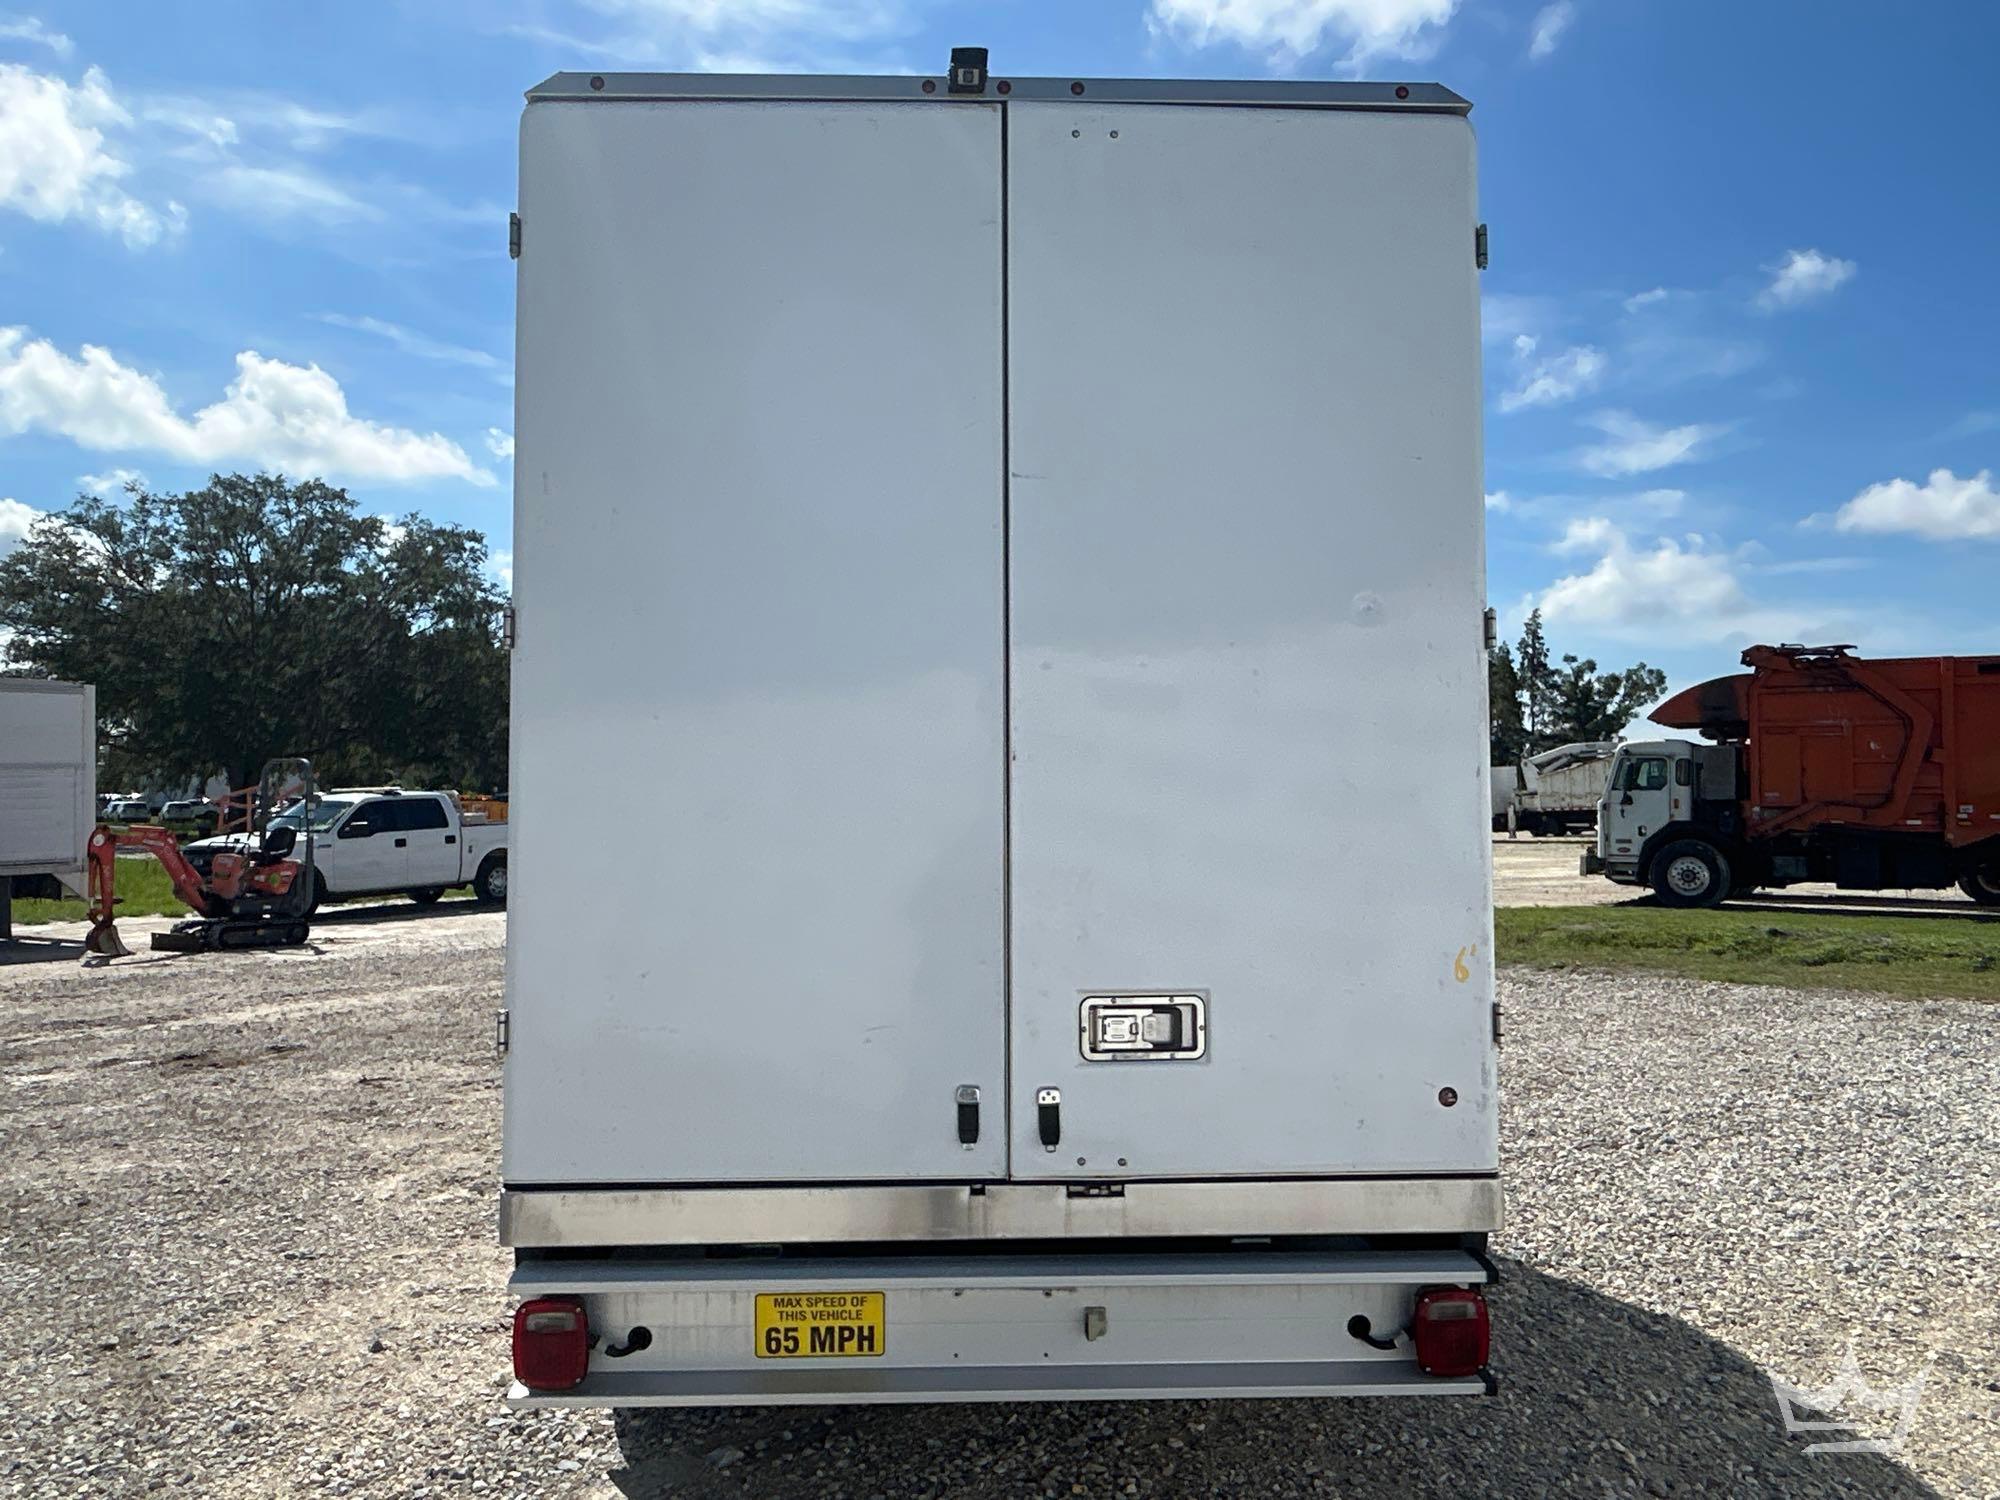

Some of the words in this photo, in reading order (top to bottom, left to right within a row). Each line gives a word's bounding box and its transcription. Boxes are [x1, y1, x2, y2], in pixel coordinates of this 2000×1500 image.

[774, 1297, 802, 1308] MAX
[806, 1296, 847, 1308] SPEED
[851, 1296, 867, 1307] OF
[778, 1310, 807, 1322] THIS
[811, 1309, 863, 1321] VEHICLE
[765, 1326, 800, 1354] 65
[810, 1325, 875, 1353] MPH
